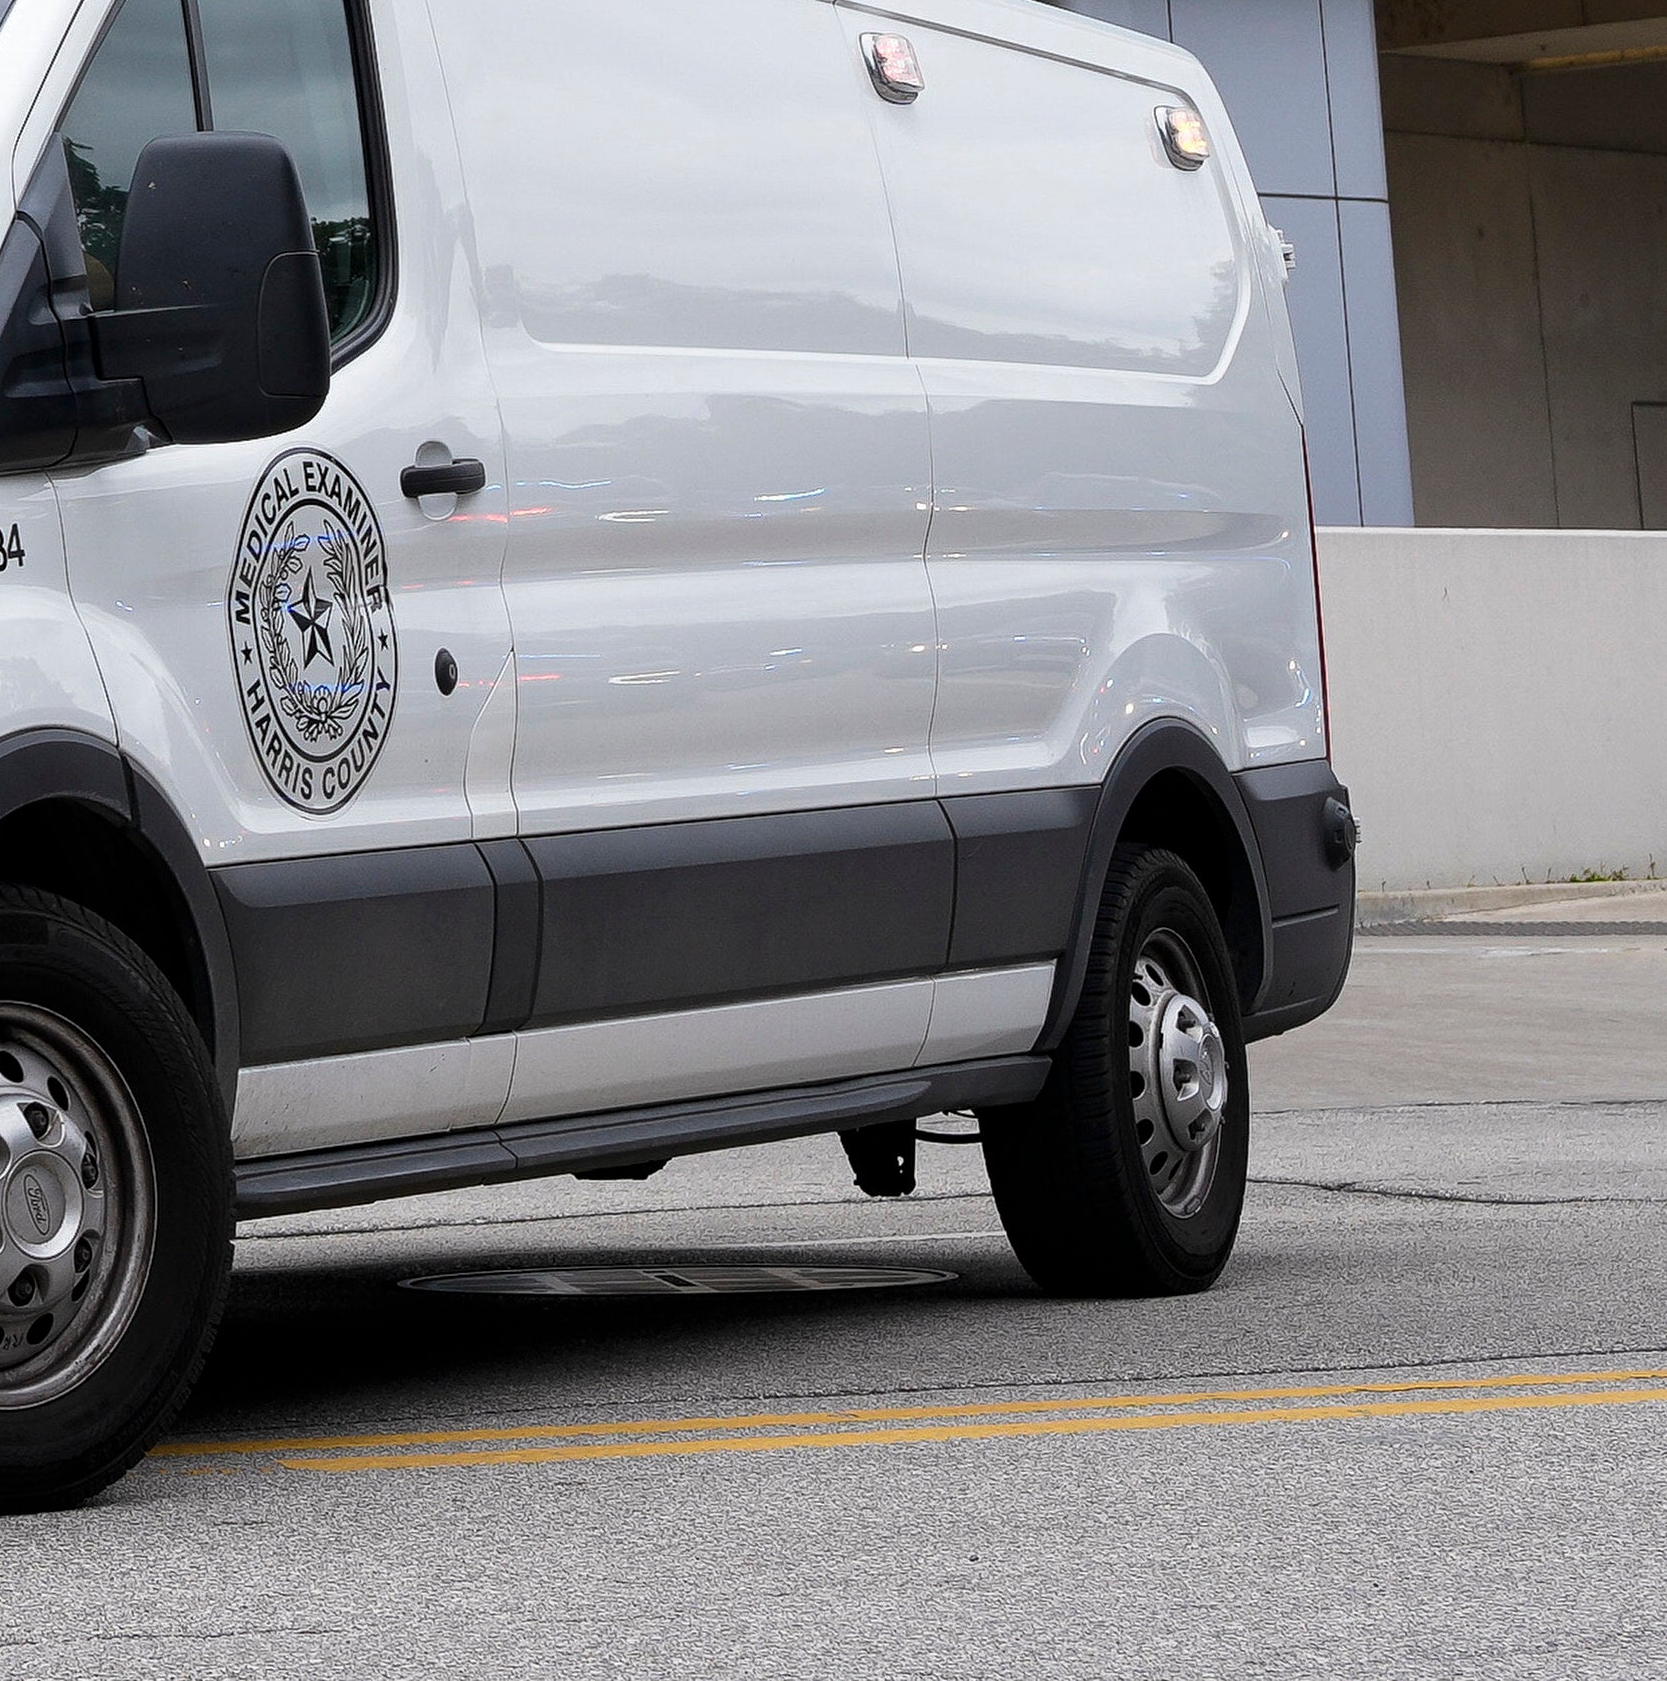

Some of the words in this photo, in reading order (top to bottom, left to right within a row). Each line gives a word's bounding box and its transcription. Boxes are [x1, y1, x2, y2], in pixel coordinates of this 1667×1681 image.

[236, 467, 300, 625] MEDICAL
[303, 460, 384, 615] EXAMINER
[246, 679, 314, 801] HARRIS
[322, 675, 392, 800] COUNTY
